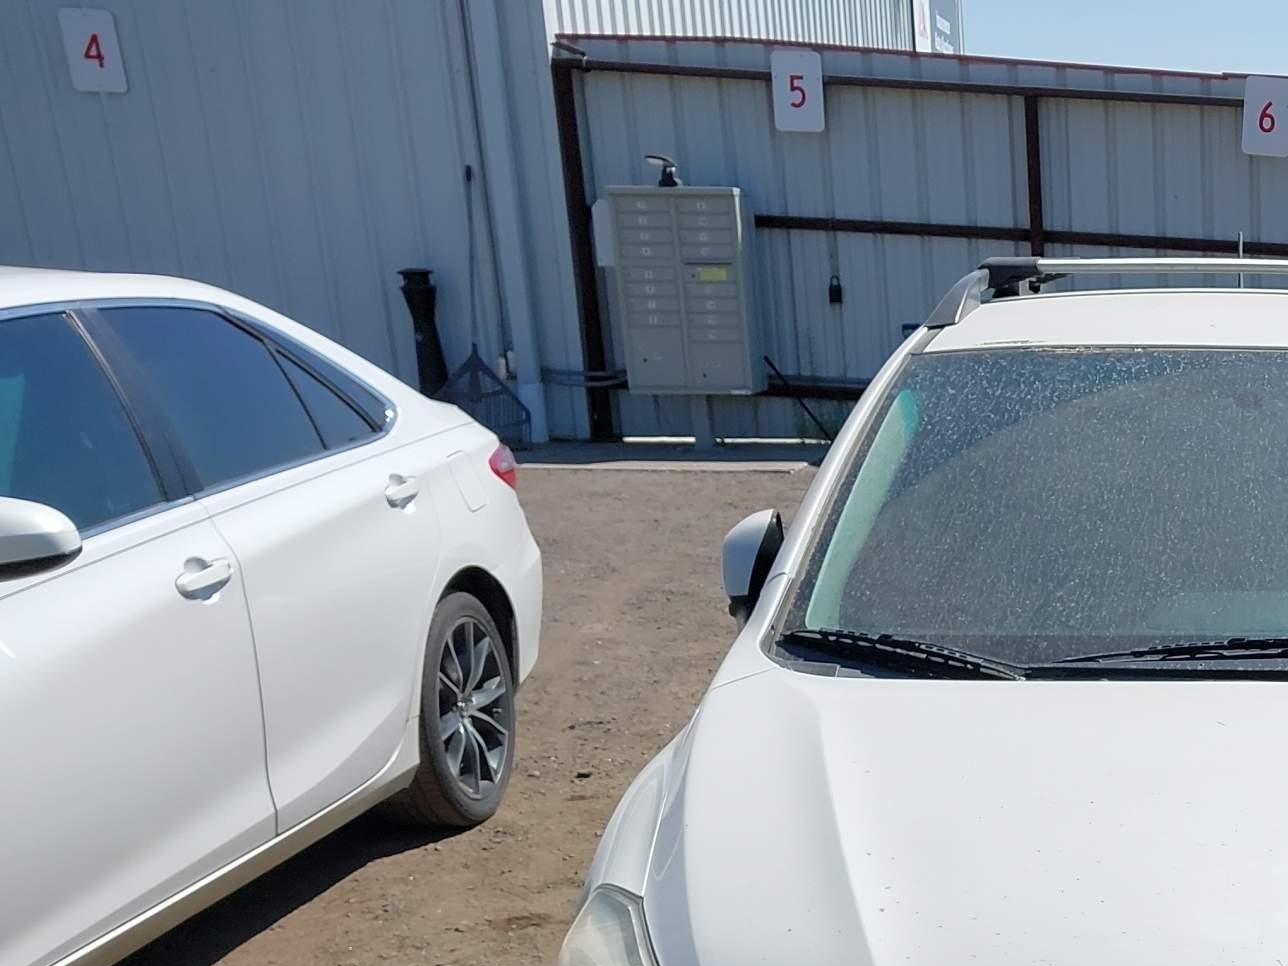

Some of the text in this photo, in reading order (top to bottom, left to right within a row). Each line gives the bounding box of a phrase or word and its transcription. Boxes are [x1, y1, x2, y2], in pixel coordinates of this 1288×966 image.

[84, 33, 105, 67] 4
[788, 74, 806, 107] 5
[1259, 102, 1276, 133] 6
